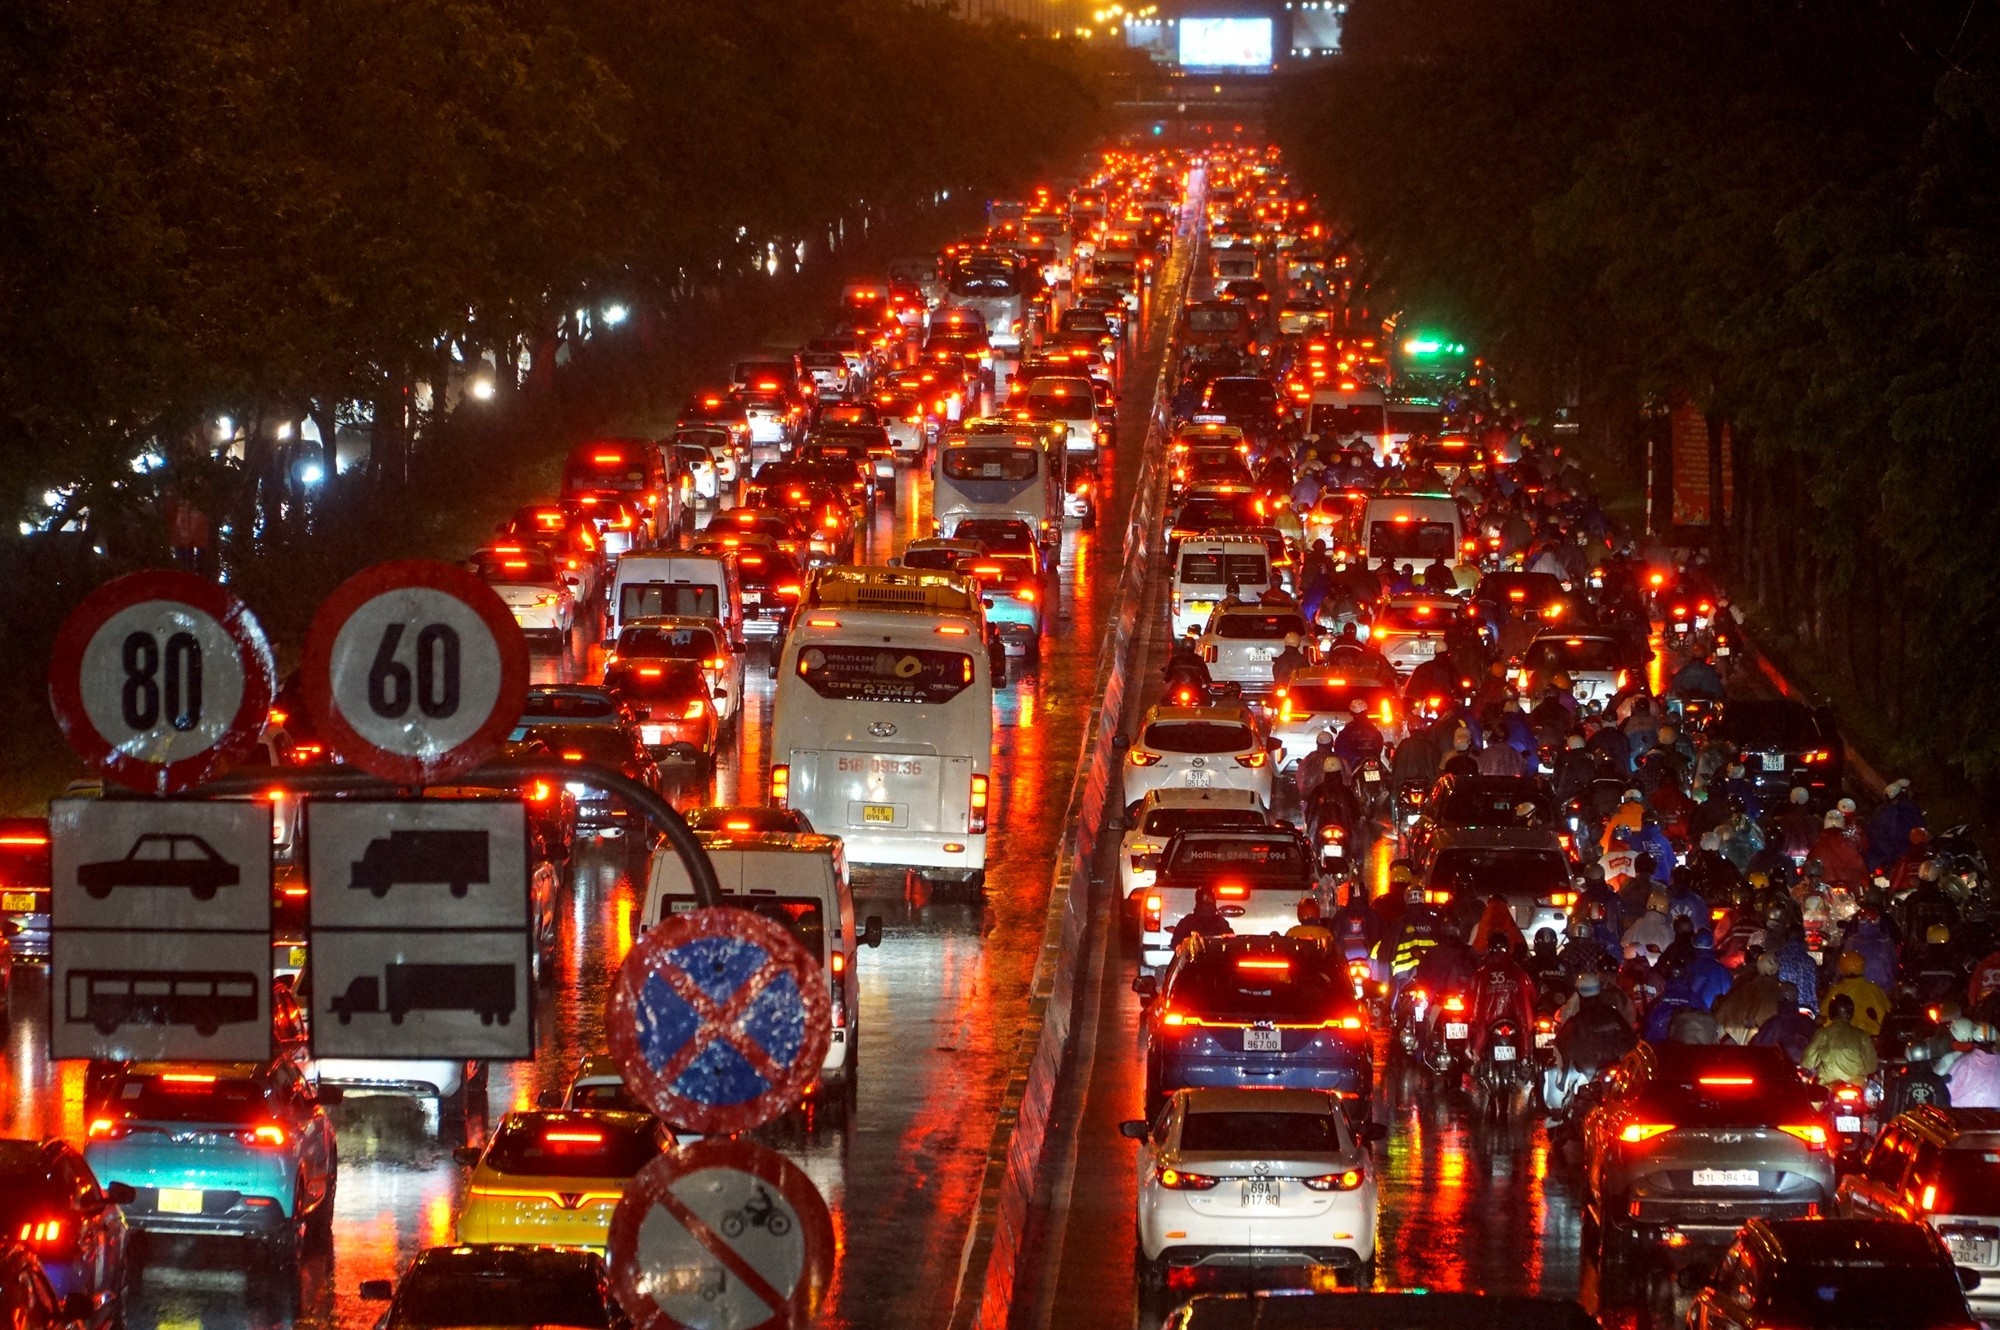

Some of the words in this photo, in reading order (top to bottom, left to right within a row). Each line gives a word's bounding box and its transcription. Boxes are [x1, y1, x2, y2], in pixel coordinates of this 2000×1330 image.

[368, 623, 461, 720] 60
[122, 631, 203, 732] 80
[1254, 1032, 1271, 1040] 51K
[1247, 1040, 1278, 1049] 967.00
[1250, 1182, 1271, 1194] 69A
